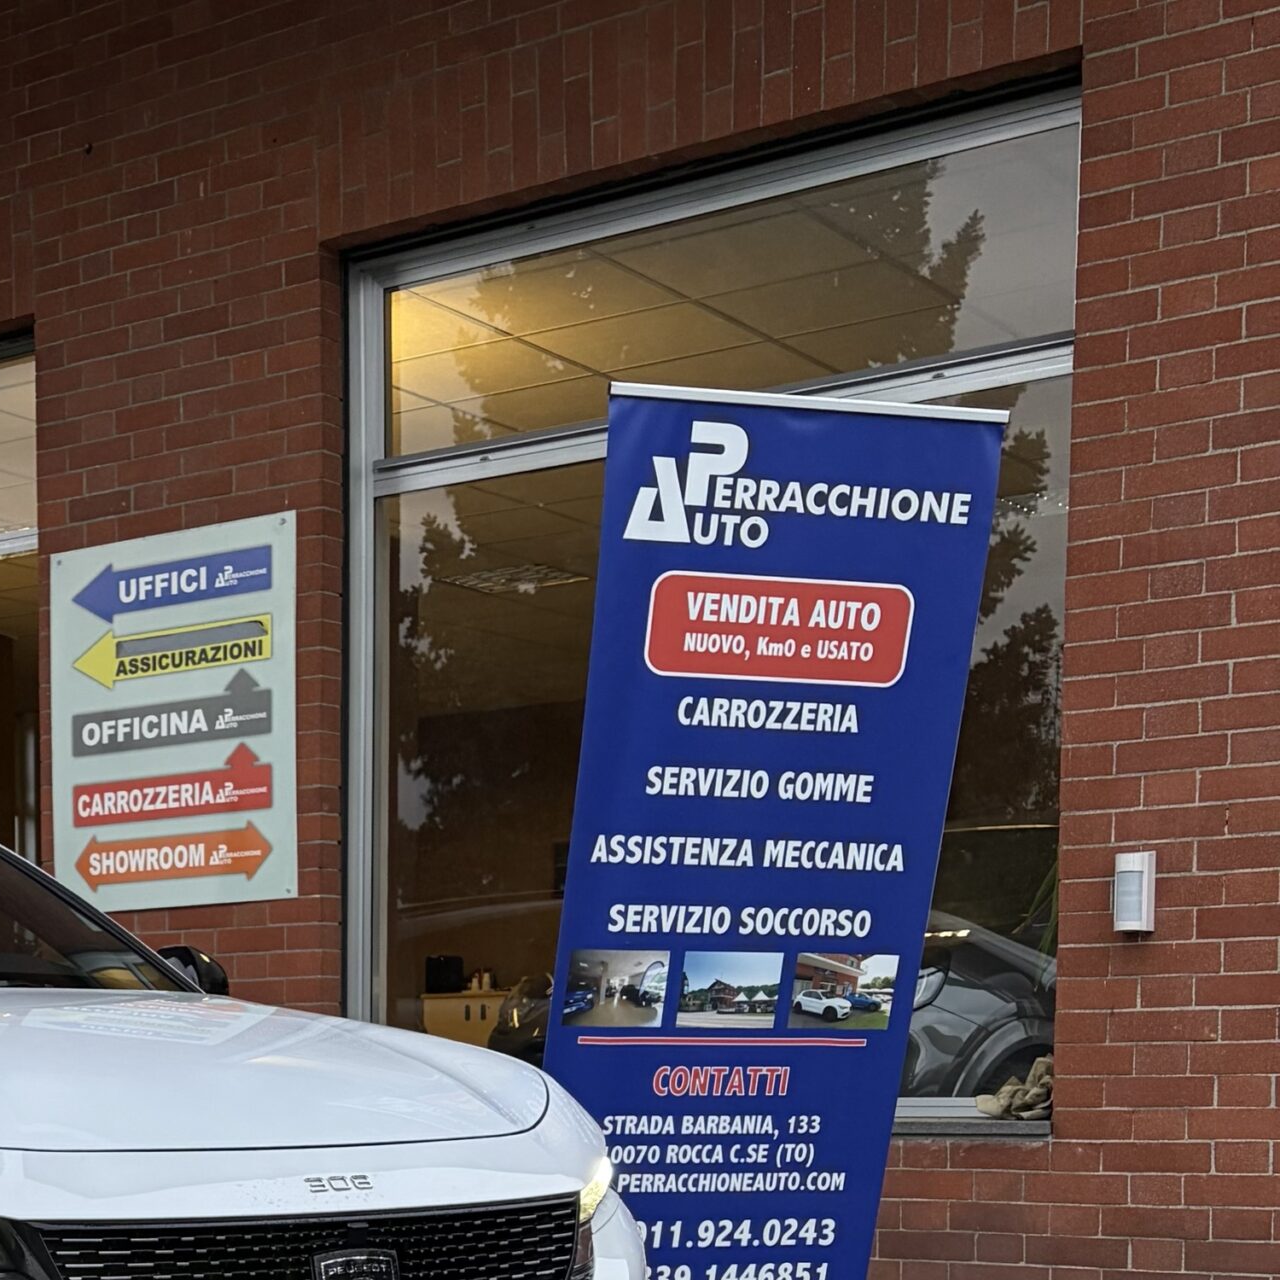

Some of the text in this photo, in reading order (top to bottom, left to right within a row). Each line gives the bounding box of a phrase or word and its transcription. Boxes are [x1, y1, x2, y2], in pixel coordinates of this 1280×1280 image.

[684, 420, 972, 525] PERRACCHIONE
[623, 455, 769, 548] AUTO
[118, 567, 207, 604] UFFICI
[686, 591, 882, 632] VENDITA AUTO
[115, 639, 263, 677] ASSICURAZIONI
[683, 632, 750, 660] NUOVO,
[800, 643, 811, 659] e
[816, 640, 874, 662] USATO
[81, 708, 208, 747] OFFICINA
[677, 696, 859, 733] CARROZZERIA
[77, 780, 214, 818] CARROZZERIA
[646, 766, 874, 803] SERVIZIO GOMME
[88, 842, 205, 877] SHOWROOM
[590, 834, 904, 872] ASSISTENZA MECCANICA
[607, 904, 872, 938] SERVIZIO SOCCORSO
[652, 1065, 790, 1097] CONTATTI
[602, 1115, 821, 1140] STRADA BARBANIA, 133
[665, 1144, 725, 1164] ROCCA
[729, 1143, 769, 1164] C.SE
[776, 1143, 815, 1168] (TO)
[617, 1172, 846, 1194] PERRACCHIONEAUTO.COM
